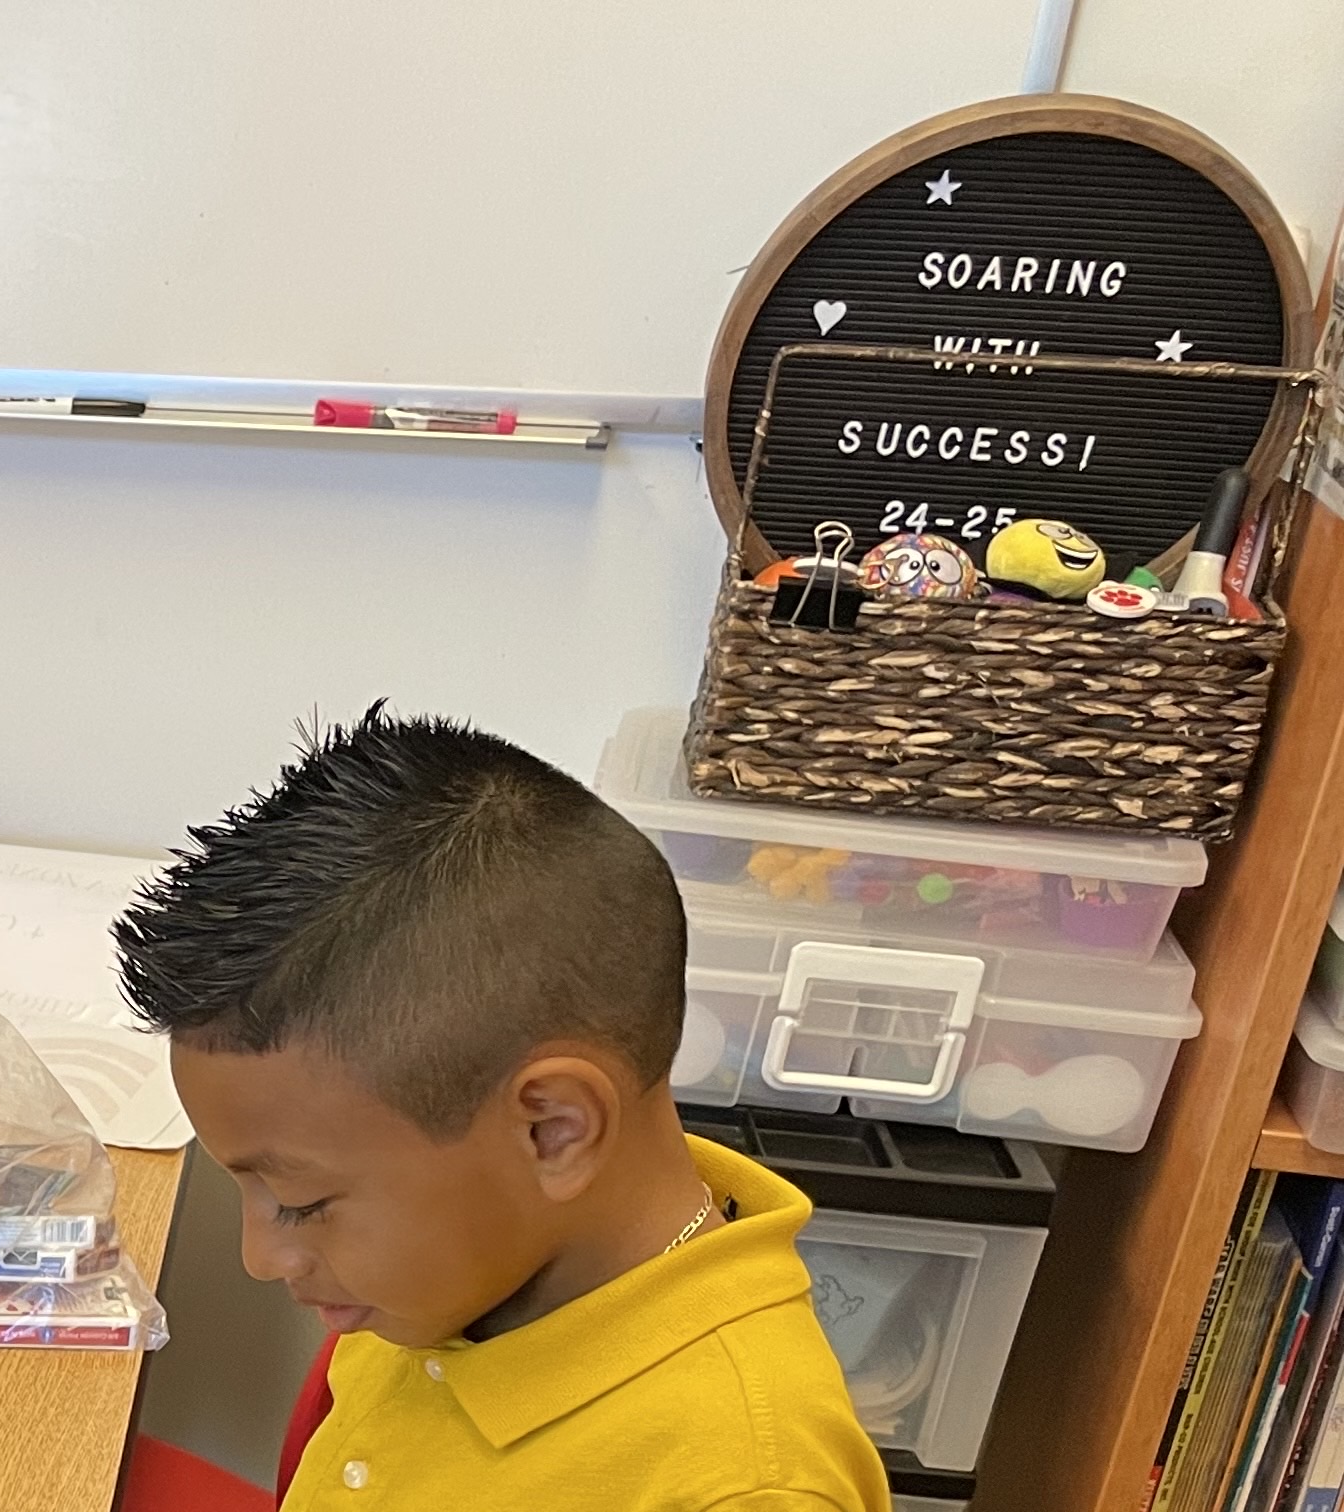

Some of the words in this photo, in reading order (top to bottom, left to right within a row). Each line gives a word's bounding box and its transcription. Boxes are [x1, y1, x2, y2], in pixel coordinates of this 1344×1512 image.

[918, 251, 1126, 298] SOARING
[933, 335, 1041, 375] WITH
[879, 500, 1017, 539] 24-25
